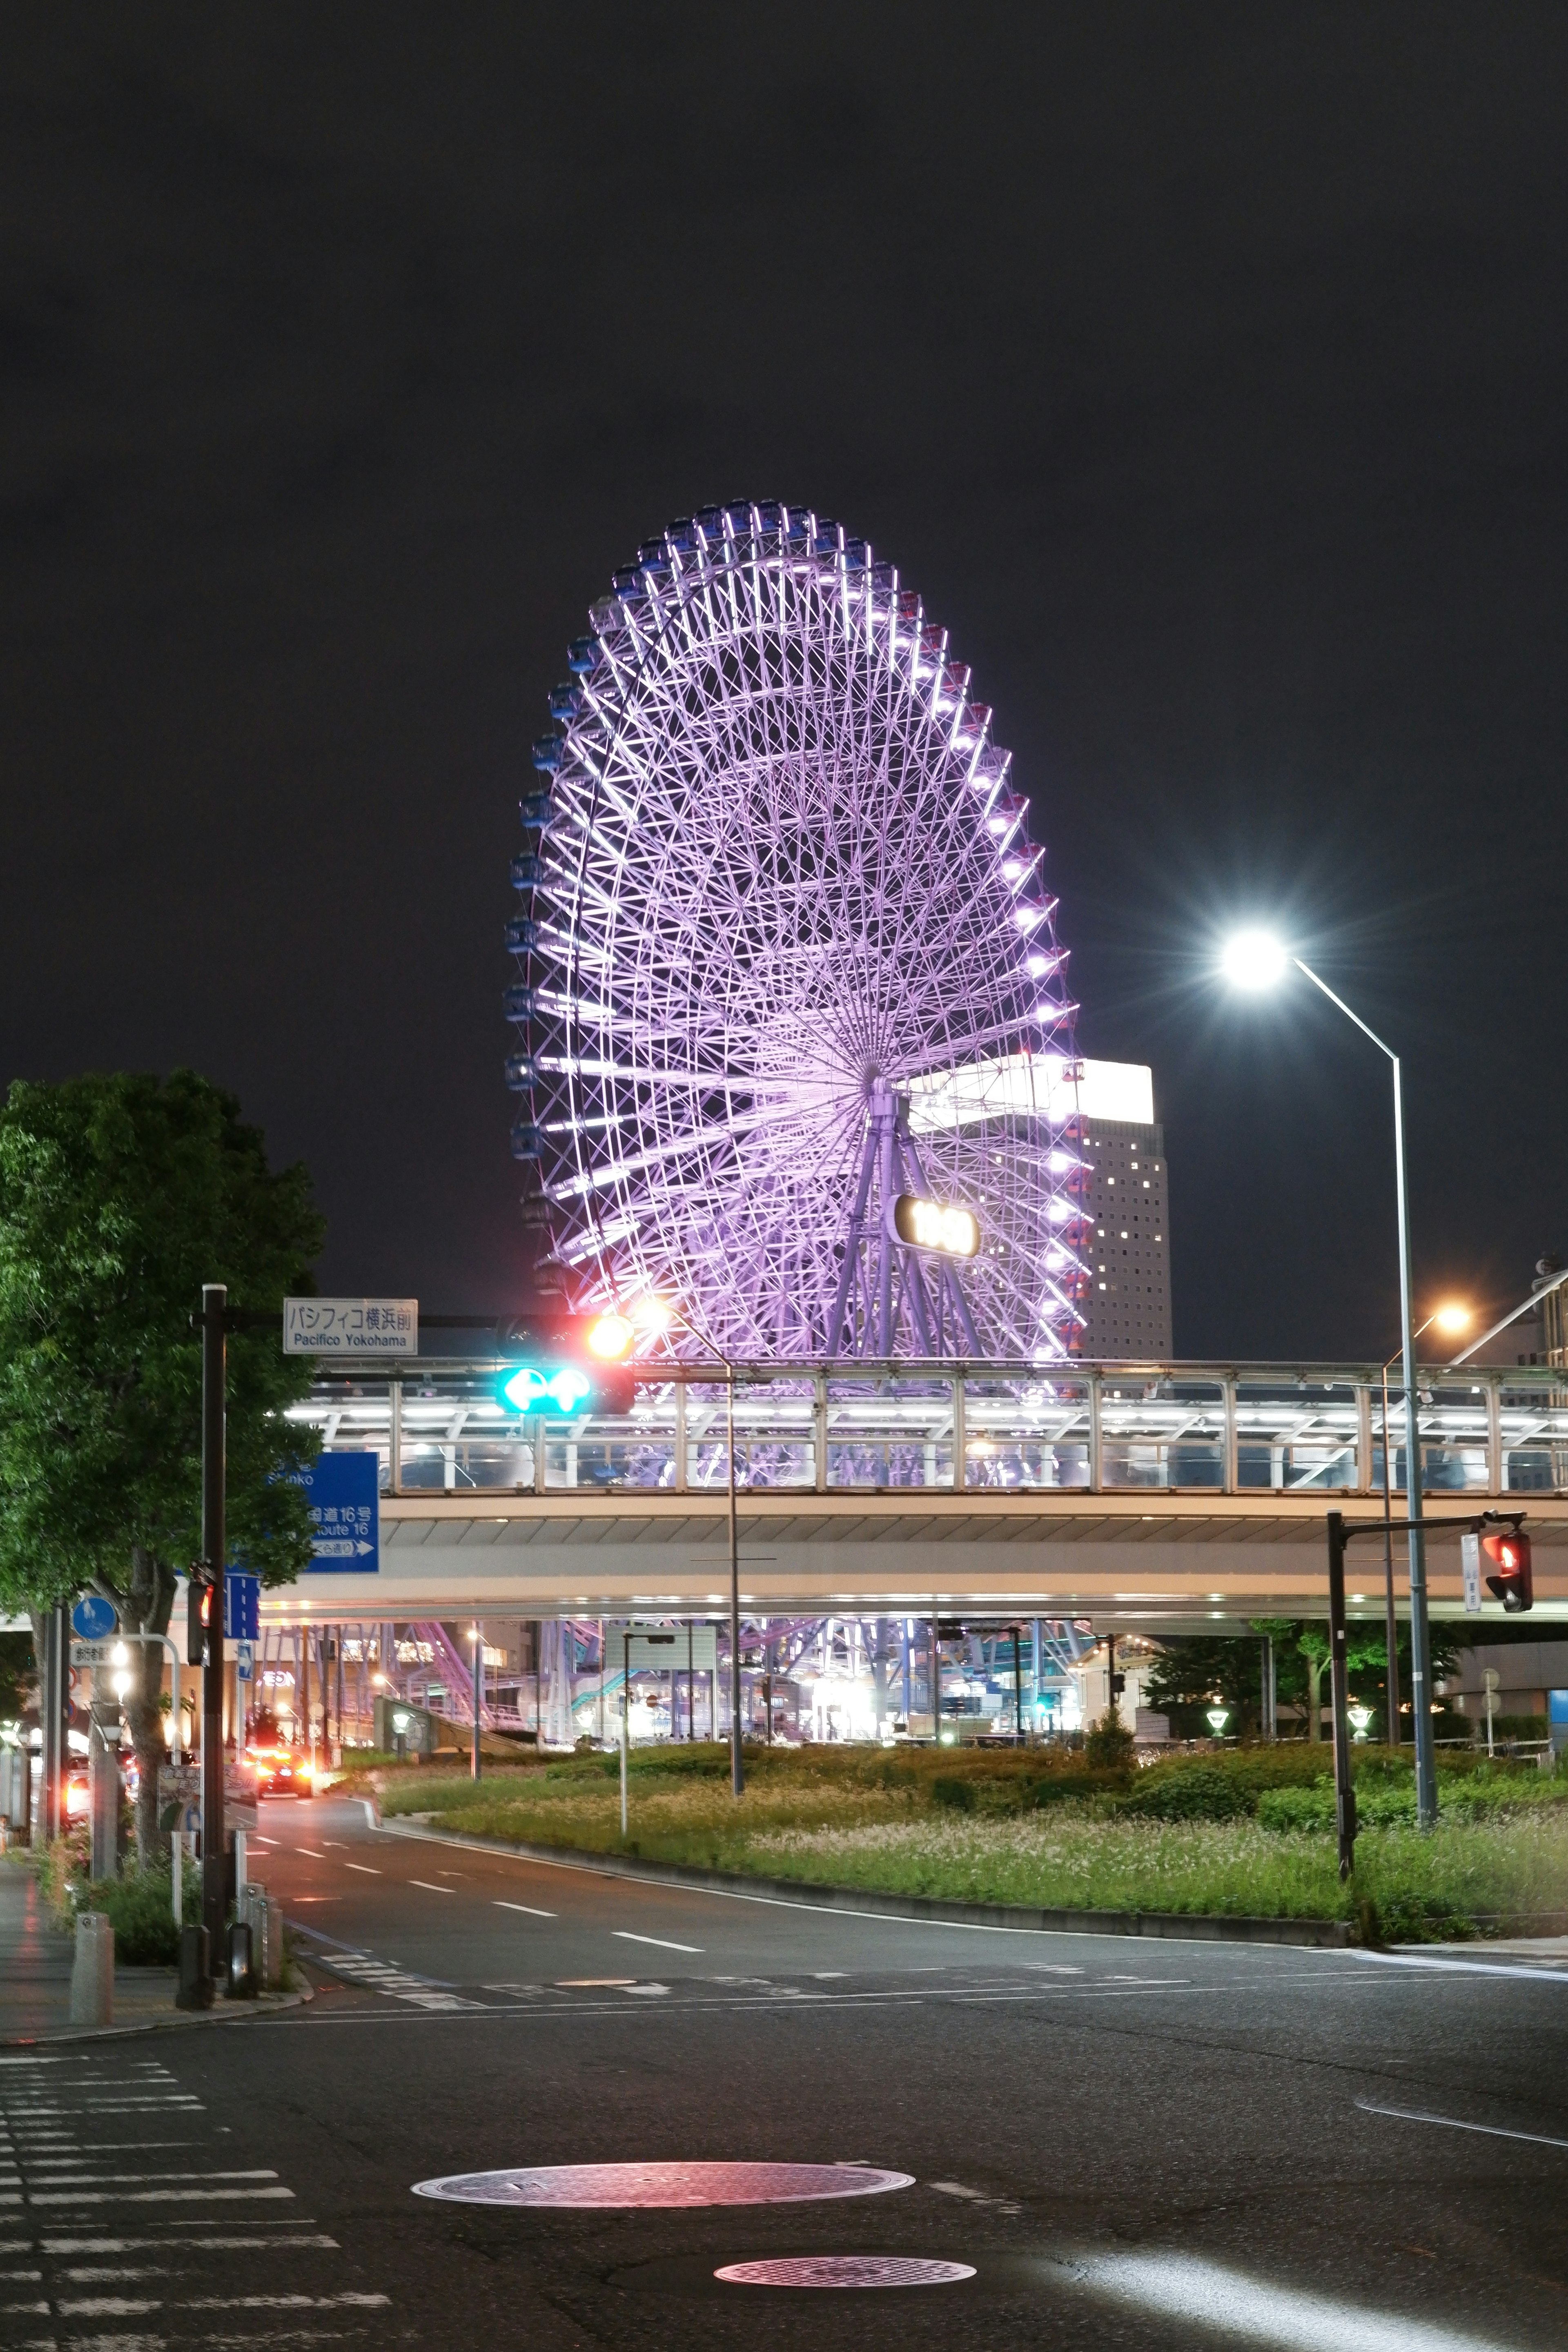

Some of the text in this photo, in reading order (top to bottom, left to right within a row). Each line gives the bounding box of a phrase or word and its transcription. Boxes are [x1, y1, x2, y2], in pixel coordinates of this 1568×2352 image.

[290, 1307, 411, 1331] パシフィコ横浜前
[294, 1333, 406, 1346] Pacifico Yokohama
[307, 1506, 372, 1523] 国道16号
[316, 1522, 369, 1536] oute 16
